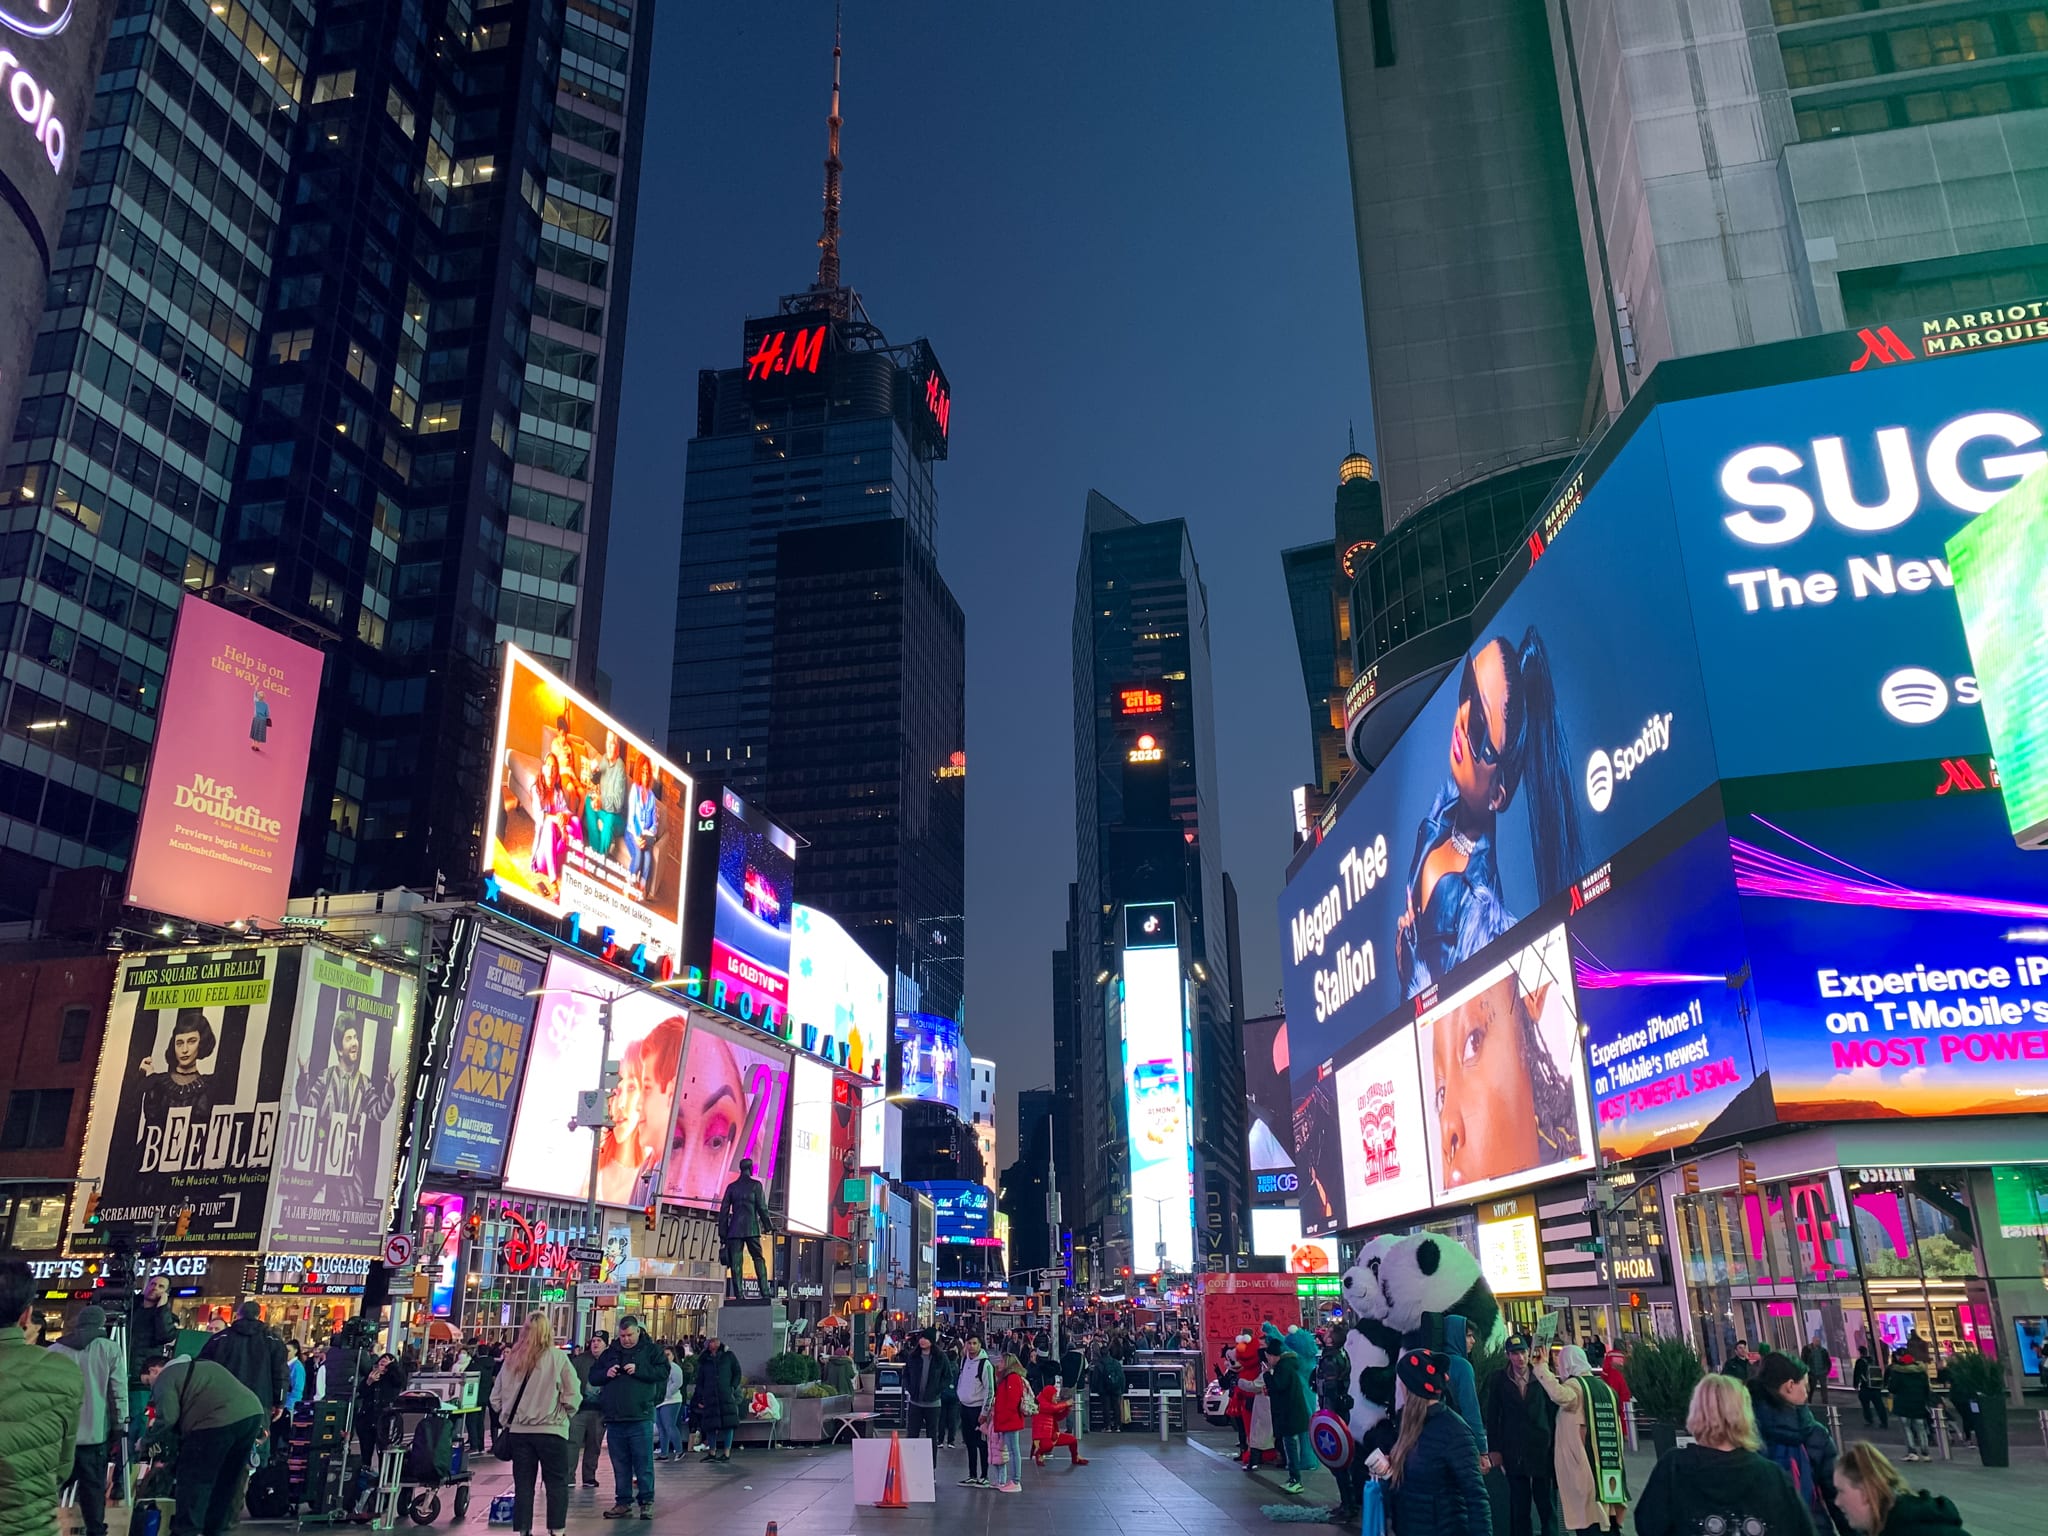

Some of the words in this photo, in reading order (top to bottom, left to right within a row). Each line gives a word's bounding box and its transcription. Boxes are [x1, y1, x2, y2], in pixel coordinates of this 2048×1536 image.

[748, 325, 826, 381] H&M
[1927, 321, 2048, 353] MARQUIS
[926, 369, 950, 438] H&M
[1721, 411, 2048, 544] SUG
[1545, 473, 1584, 530] MARRIOTT
[1547, 493, 1582, 544] MARQUIS
[1728, 568, 1837, 611] The
[211, 656, 232, 673] the
[235, 667, 260, 688] way,
[263, 677, 292, 697] dear.
[224, 645, 254, 669] Help
[257, 659, 267, 673] is
[269, 667, 284, 680] on
[1346, 665, 1378, 707] MARRIOTT
[1129, 750, 1161, 762] 2020
[1613, 712, 1673, 781] Spotify
[192, 773, 237, 800] Mrs.
[173, 785, 281, 836] Doubtfire
[730, 799, 740, 813] LG
[175, 824, 213, 843] Previews
[215, 835, 238, 850] begin
[239, 843, 266, 857] March
[698, 820, 714, 831] LG
[1582, 862, 1612, 889] MARRIOTT
[565, 872, 582, 889] Then
[584, 884, 593, 896] go
[594, 888, 610, 904] back
[612, 898, 619, 908] to
[620, 902, 631, 915] not
[1291, 884, 1342, 966] Megan
[1340, 834, 1388, 911] Thee
[281, 916, 327, 926] LAMAR
[129, 966, 157, 986] TIMES
[160, 965, 199, 985] SQUARE
[201, 963, 220, 979] CAN
[223, 960, 262, 977] REALLY
[319, 964, 344, 985] RAISING
[346, 975, 369, 993] SPIRITS
[487, 966, 503, 983] BEST
[502, 970, 526, 992] MUSICAL
[728, 956, 739, 974] LG
[739, 962, 758, 984] OLED
[759, 970, 768, 988] TV
[1313, 939, 1376, 1023] Stallion
[1817, 963, 2010, 1002] Experience
[149, 990, 178, 1005] MAKE
[183, 988, 201, 1003] YOU
[205, 986, 230, 1001] FEEL
[233, 984, 267, 1000] ALIVE!
[346, 994, 356, 1009] ON
[356, 996, 394, 1020] BROADWAY!
[472, 999, 489, 1013] COME
[489, 1004, 518, 1022] TOGETHER
[518, 1015, 526, 1024] AT
[687, 965, 850, 1067] BROADWAY
[1825, 1010, 1869, 1034] on
[467, 1010, 523, 1050] COME
[1591, 1029, 1647, 1067] Experience
[1647, 1011, 1689, 1044] iPhone
[1690, 999, 1703, 1024] 11
[1595, 1074, 1607, 1095] on
[1664, 1033, 1709, 1071] newest
[1831, 1036, 1929, 1069] MOST
[1939, 1029, 2048, 1064] POWE
[453, 1064, 514, 1102] AWAY
[1598, 1094, 1628, 1123] MOST
[1629, 1073, 1690, 1113] POWERFUL
[1691, 1056, 1741, 1094] SIGNAL
[139, 1109, 276, 1173] BEETLE
[170, 1176, 185, 1187] The
[222, 1174, 236, 1184] The
[1257, 1175, 1276, 1184] TEEN
[1277, 1173, 1298, 1191] OG
[1258, 1184, 1277, 1193] MOM
[291, 1206, 341, 1221] JAW-DROPPING
[227, 1232, 257, 1240] BROADWAY
[264, 1254, 303, 1273] GIFTS
[313, 1256, 371, 1275] LUGGAGE
[1601, 1257, 1655, 1280] SPHORA
[672, 1294, 699, 1310] FOREVER
